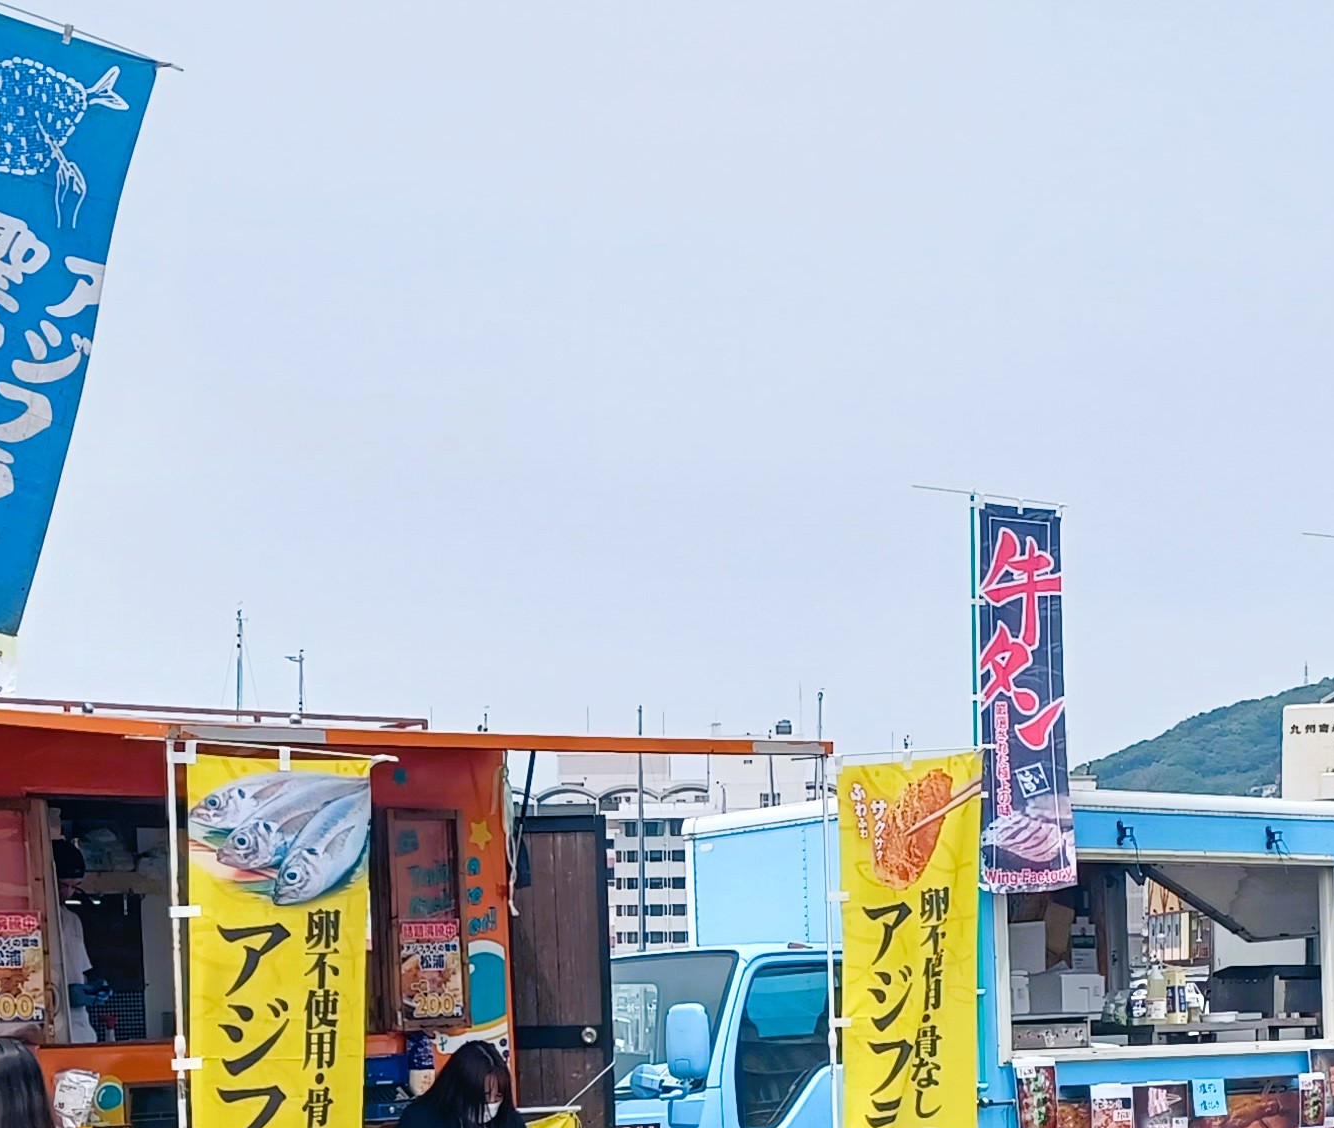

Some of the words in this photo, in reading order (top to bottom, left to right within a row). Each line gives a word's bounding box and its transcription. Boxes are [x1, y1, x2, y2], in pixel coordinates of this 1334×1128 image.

[981, 527, 1066, 750] 牛タン
[985, 869, 1017, 886] Wing
[1018, 867, 1073, 885] Factory
[420, 954, 446, 970] 松浦
